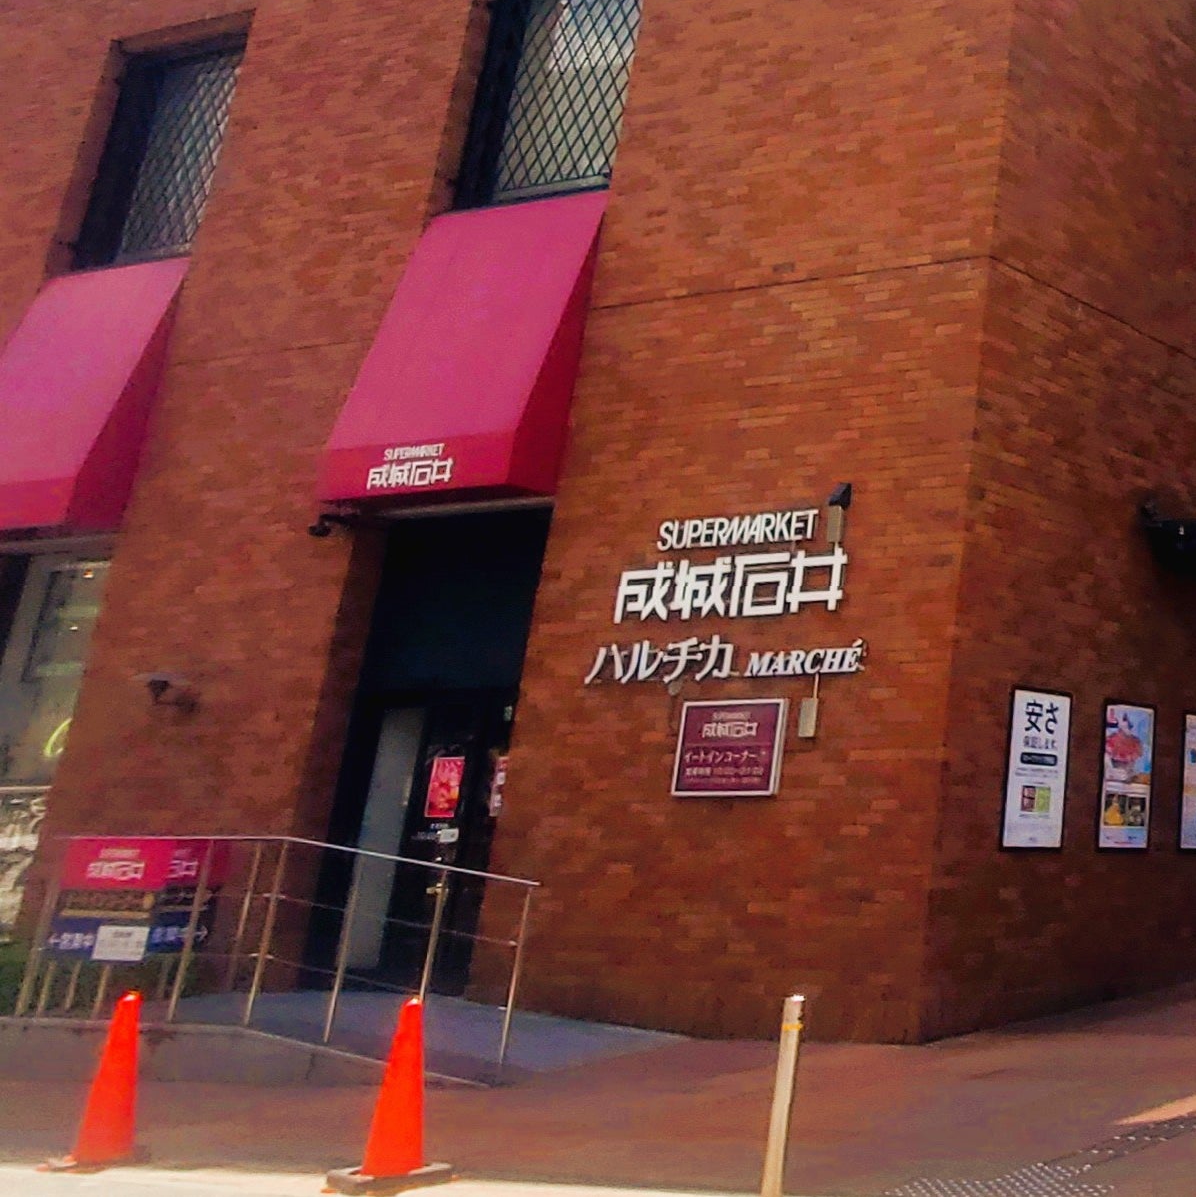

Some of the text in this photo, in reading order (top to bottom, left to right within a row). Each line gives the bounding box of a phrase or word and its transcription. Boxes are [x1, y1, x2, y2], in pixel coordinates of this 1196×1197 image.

[366, 458, 454, 490] 成城石井
[656, 508, 819, 552] SUPERMARKET
[613, 546, 848, 624] 成城石井
[584, 634, 867, 686] ハルチカ MARCHÉ
[1024, 699, 1059, 735] 安さ
